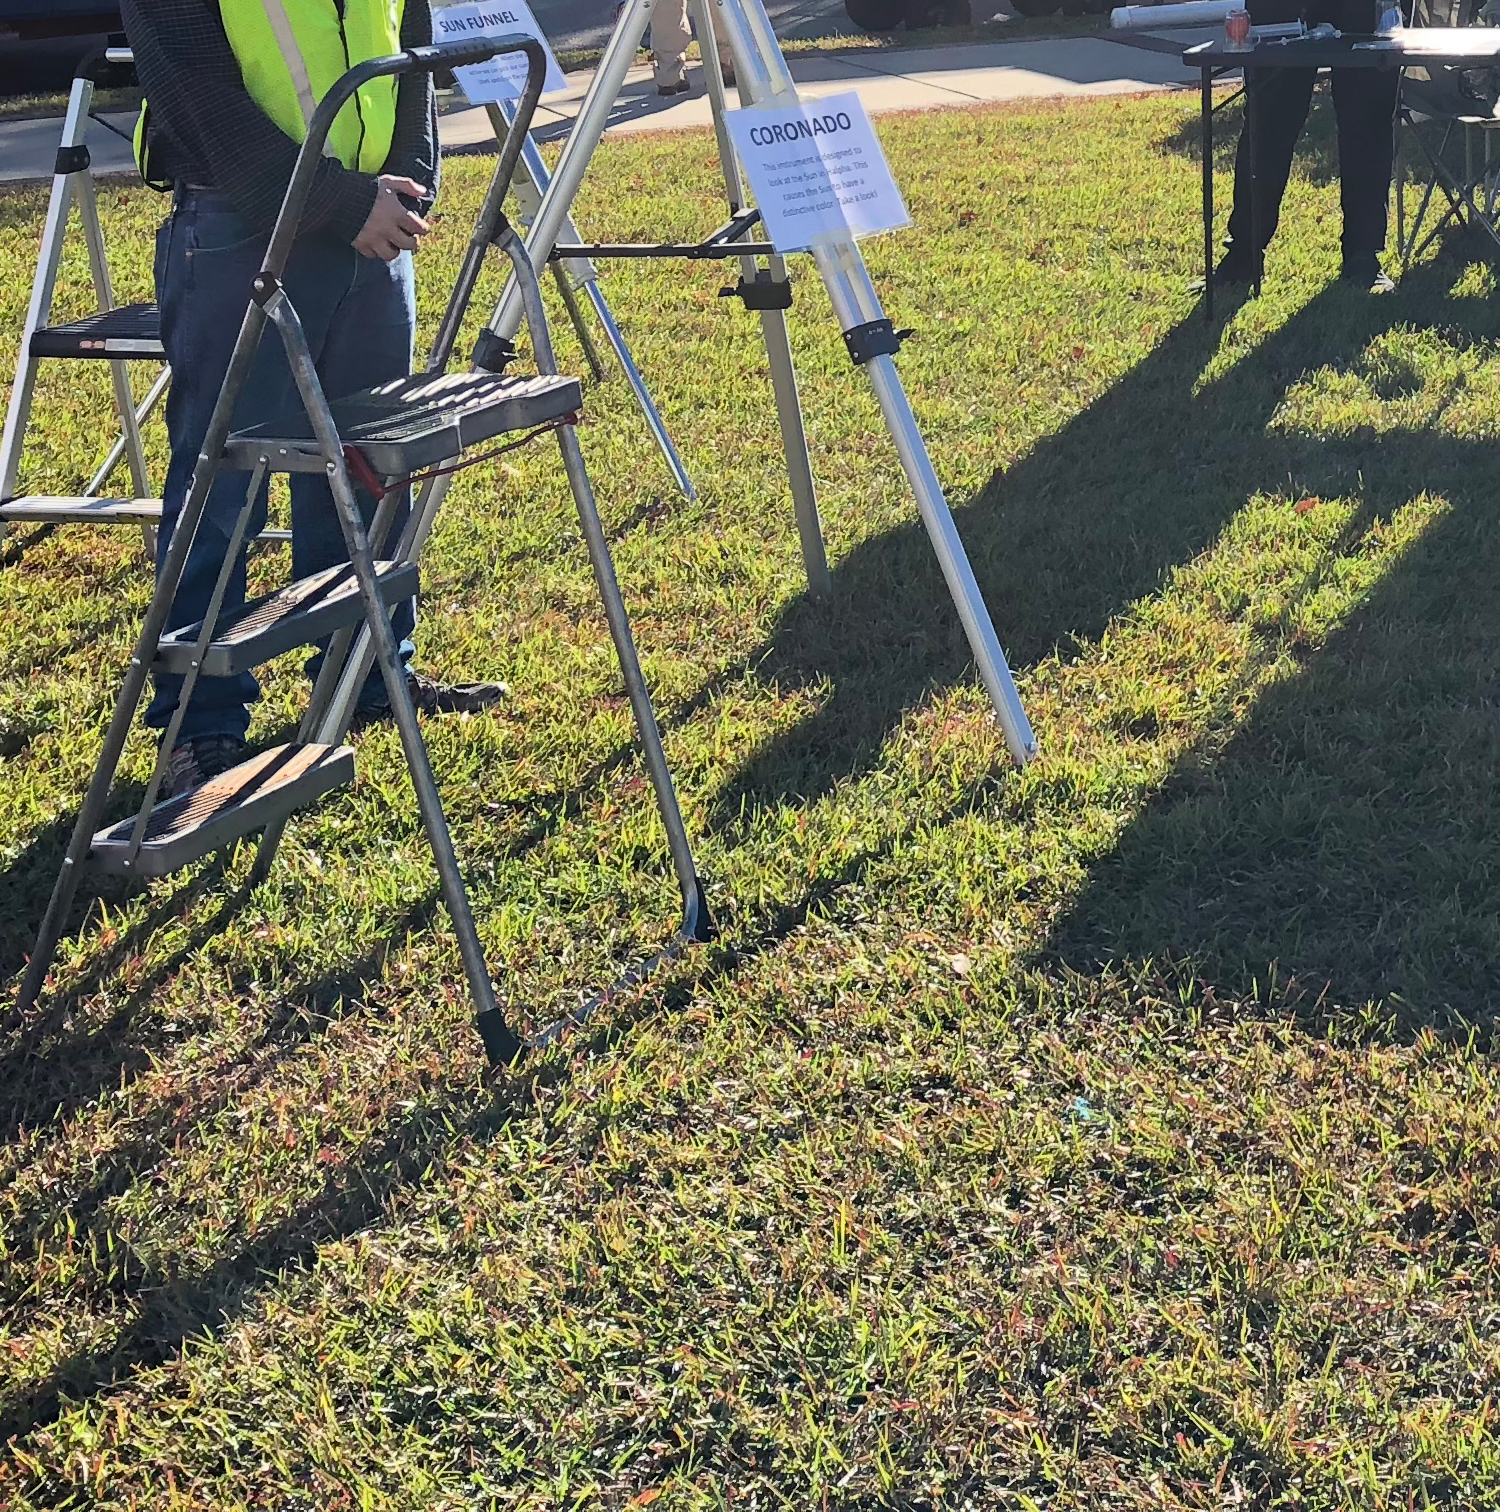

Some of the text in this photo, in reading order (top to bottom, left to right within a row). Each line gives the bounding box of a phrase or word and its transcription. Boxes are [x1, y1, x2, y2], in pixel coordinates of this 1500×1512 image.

[439, 10, 519, 33] SUN FUNNEL
[750, 112, 851, 146] CORONADO
